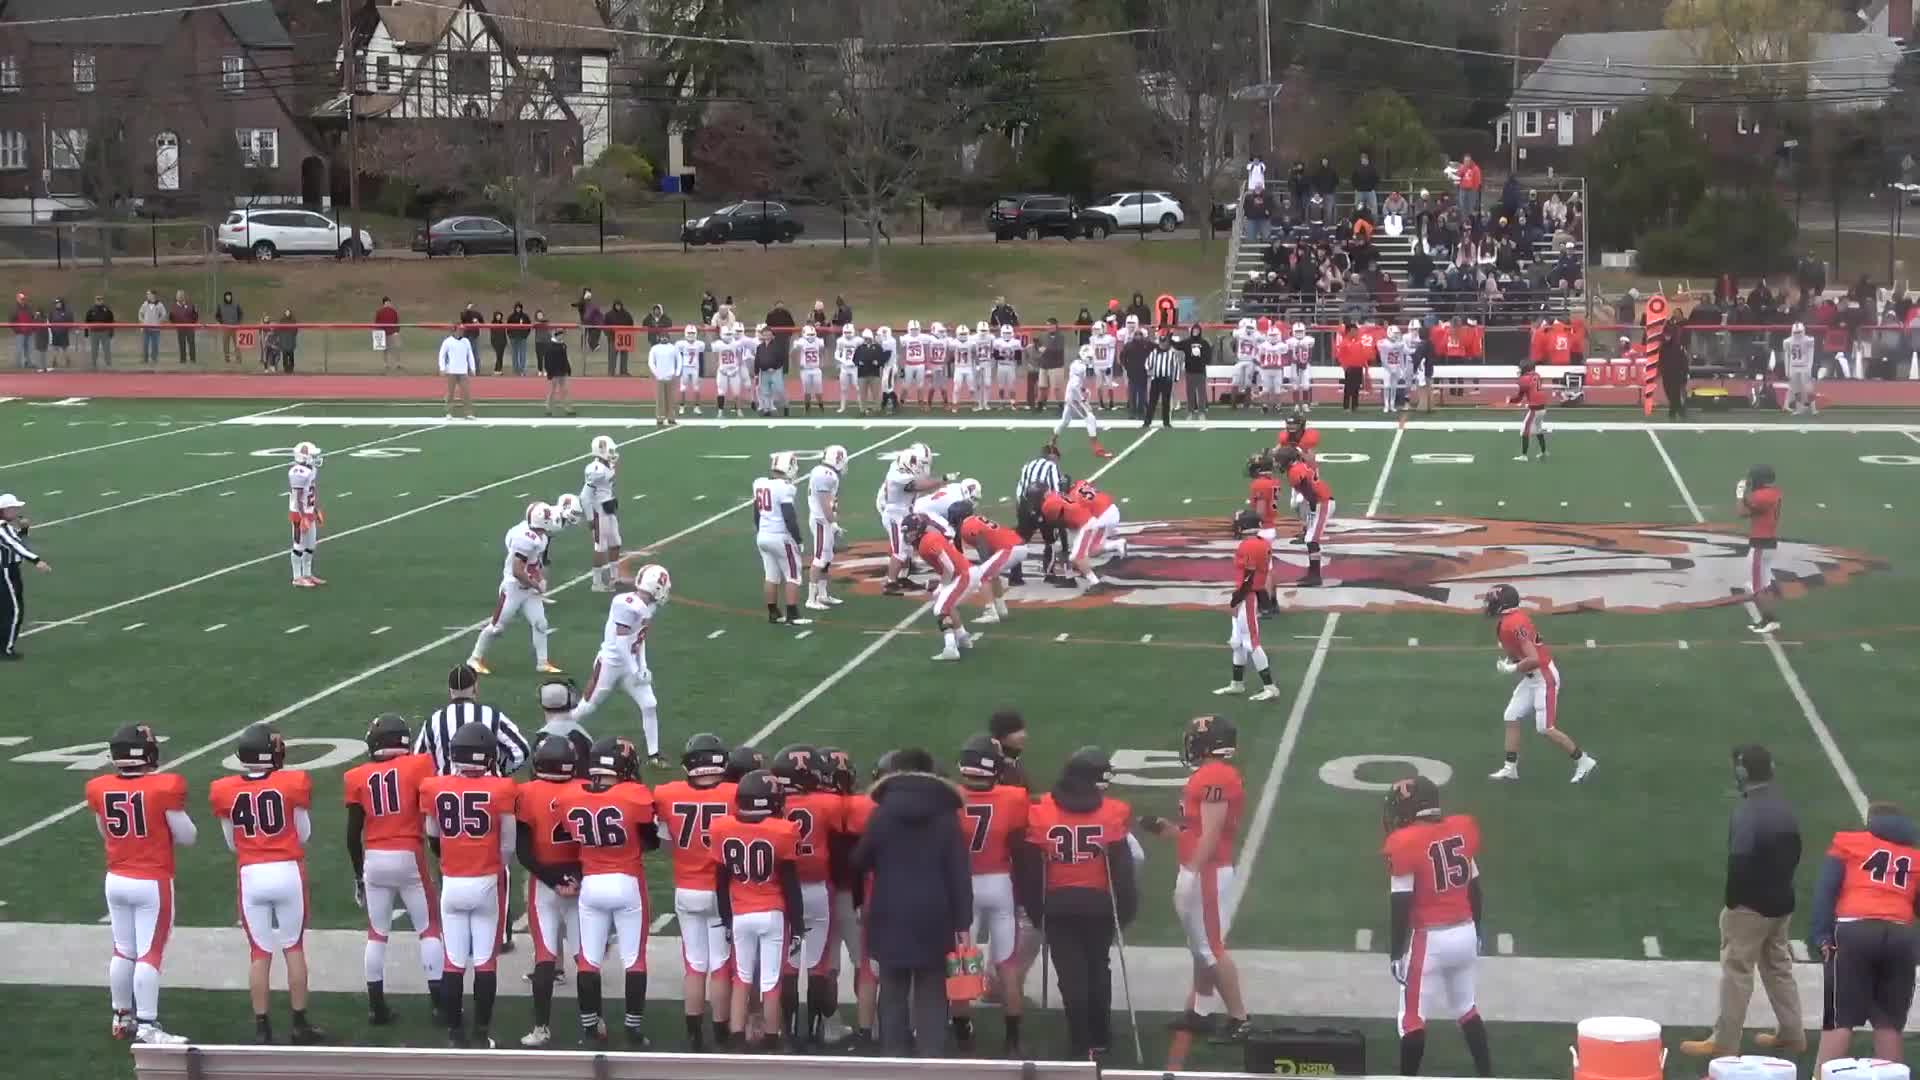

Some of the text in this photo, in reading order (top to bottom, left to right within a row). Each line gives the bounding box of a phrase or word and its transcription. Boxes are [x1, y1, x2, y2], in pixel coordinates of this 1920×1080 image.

[238, 333, 254, 346] 20
[617, 333, 632, 347] 30
[688, 351, 695, 364] 7
[756, 488, 772, 512] 60
[1193, 716, 1214, 731] T
[788, 751, 812, 770] T
[831, 751, 849, 770] T
[367, 767, 400, 817] 11
[1392, 778, 1417, 799] T
[104, 790, 149, 840] 51
[231, 789, 288, 838] 40
[435, 790, 492, 840] 85
[566, 805, 628, 848] 36
[672, 801, 728, 850] 75
[965, 803, 994, 853] 7
[722, 837, 775, 886] 80
[1047, 823, 1104, 864] 35
[1427, 834, 1471, 893] 15
[1859, 847, 1912, 890] 41
